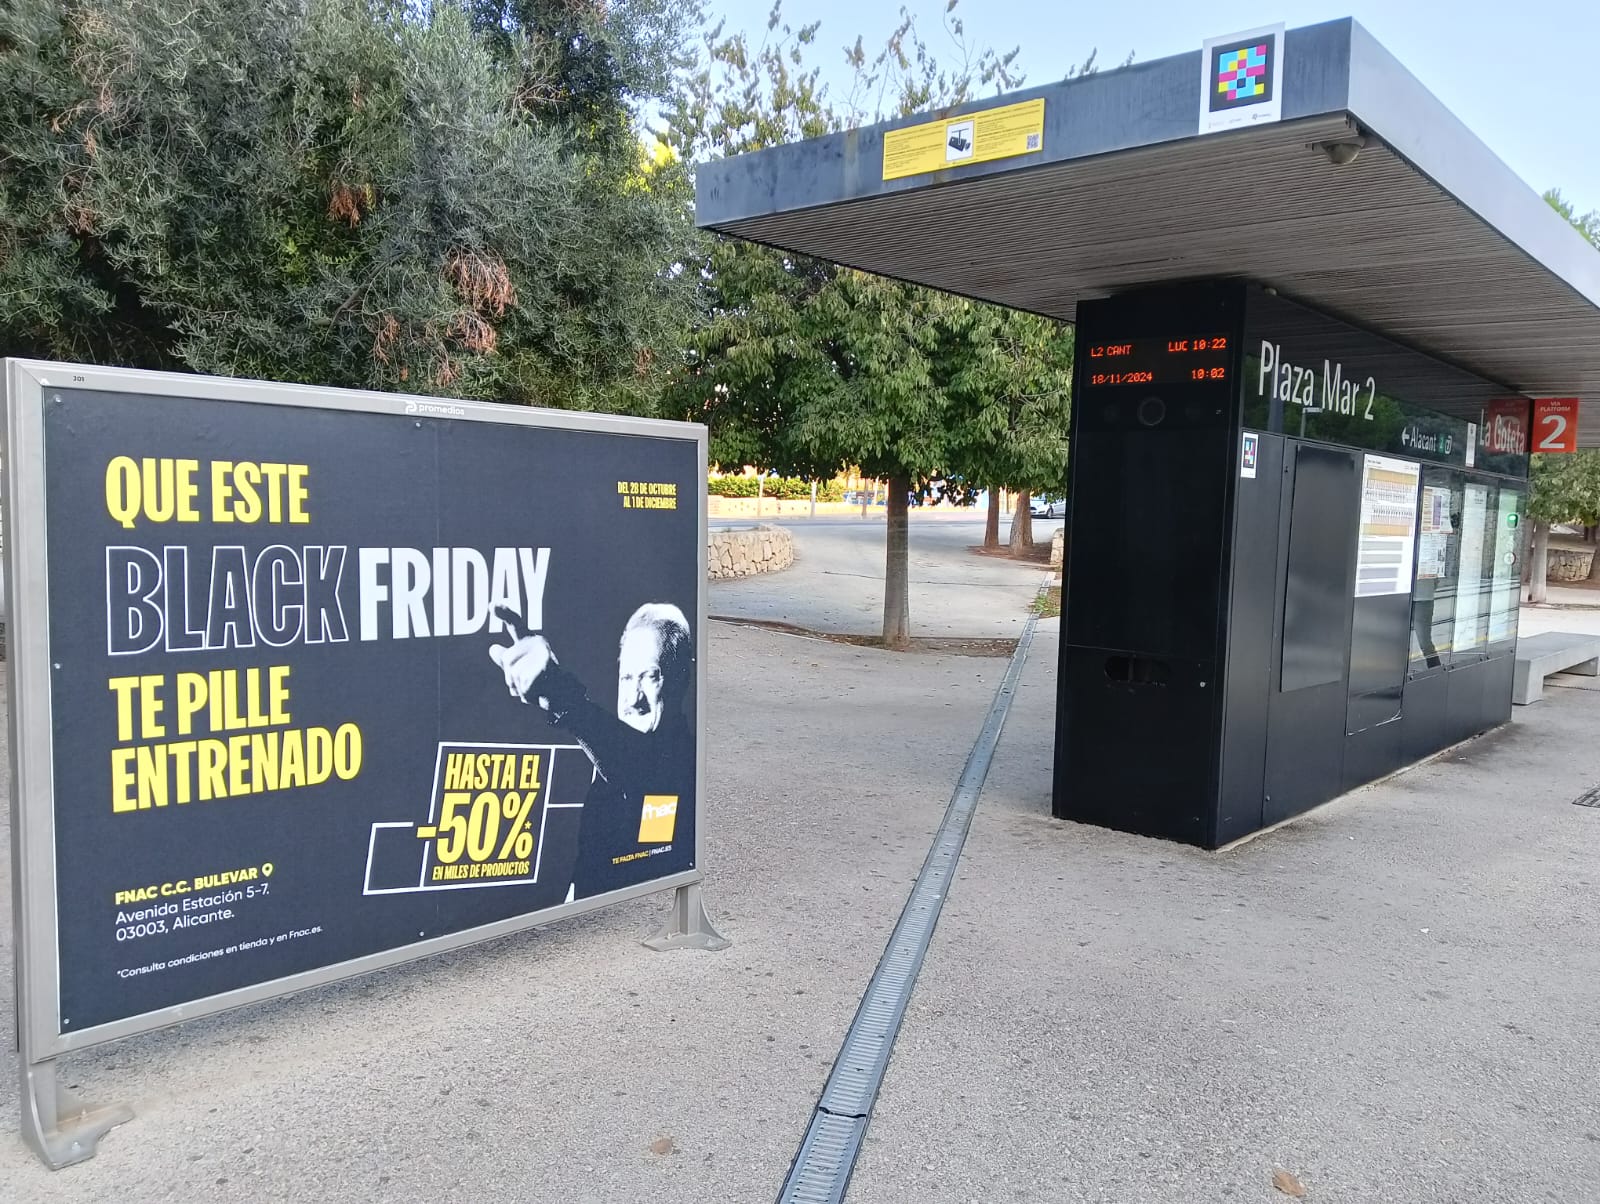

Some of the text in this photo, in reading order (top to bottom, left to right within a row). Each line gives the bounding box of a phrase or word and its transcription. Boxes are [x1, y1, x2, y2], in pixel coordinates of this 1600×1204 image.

[1090, 338, 1227, 357] L2 CANT LUC 10:22
[1091, 367, 1225, 385] 18/11/2024 10:02
[1259, 340, 1376, 421] Plaza Mar 2
[418, 404, 465, 416] promedios
[1479, 408, 1492, 447] La
[1409, 426, 1437, 453] Alacant
[1539, 414, 1567, 449] 2
[105, 455, 310, 529] QUE ESTE
[617, 481, 677, 496] DEL 28 DE OCTUBRE
[623, 495, 677, 509] AL 1 DE DICIEMBRE
[105, 544, 552, 657] BLACK FRIDAY
[108, 665, 290, 742] TE PILLE
[111, 722, 362, 813] ENTRENADO
[443, 753, 541, 790] HASTA EL
[642, 802, 677, 820] fnac
[432, 861, 530, 880] EN MILES DE PRODUCTOS
[612, 845, 672, 865] TE FALTA FNAC FNAC.ES
[115, 867, 258, 905] FNAC C.C. BULEVAR
[115, 883, 270, 925] Avenida Estación 5-7.
[115, 909, 235, 942] 03003, Alicante.
[167, 949, 225, 968] condiciones
[225, 946, 238, 955] en
[239, 938, 268, 951] tienda
[269, 935, 276, 946] y
[276, 933, 288, 943] en
